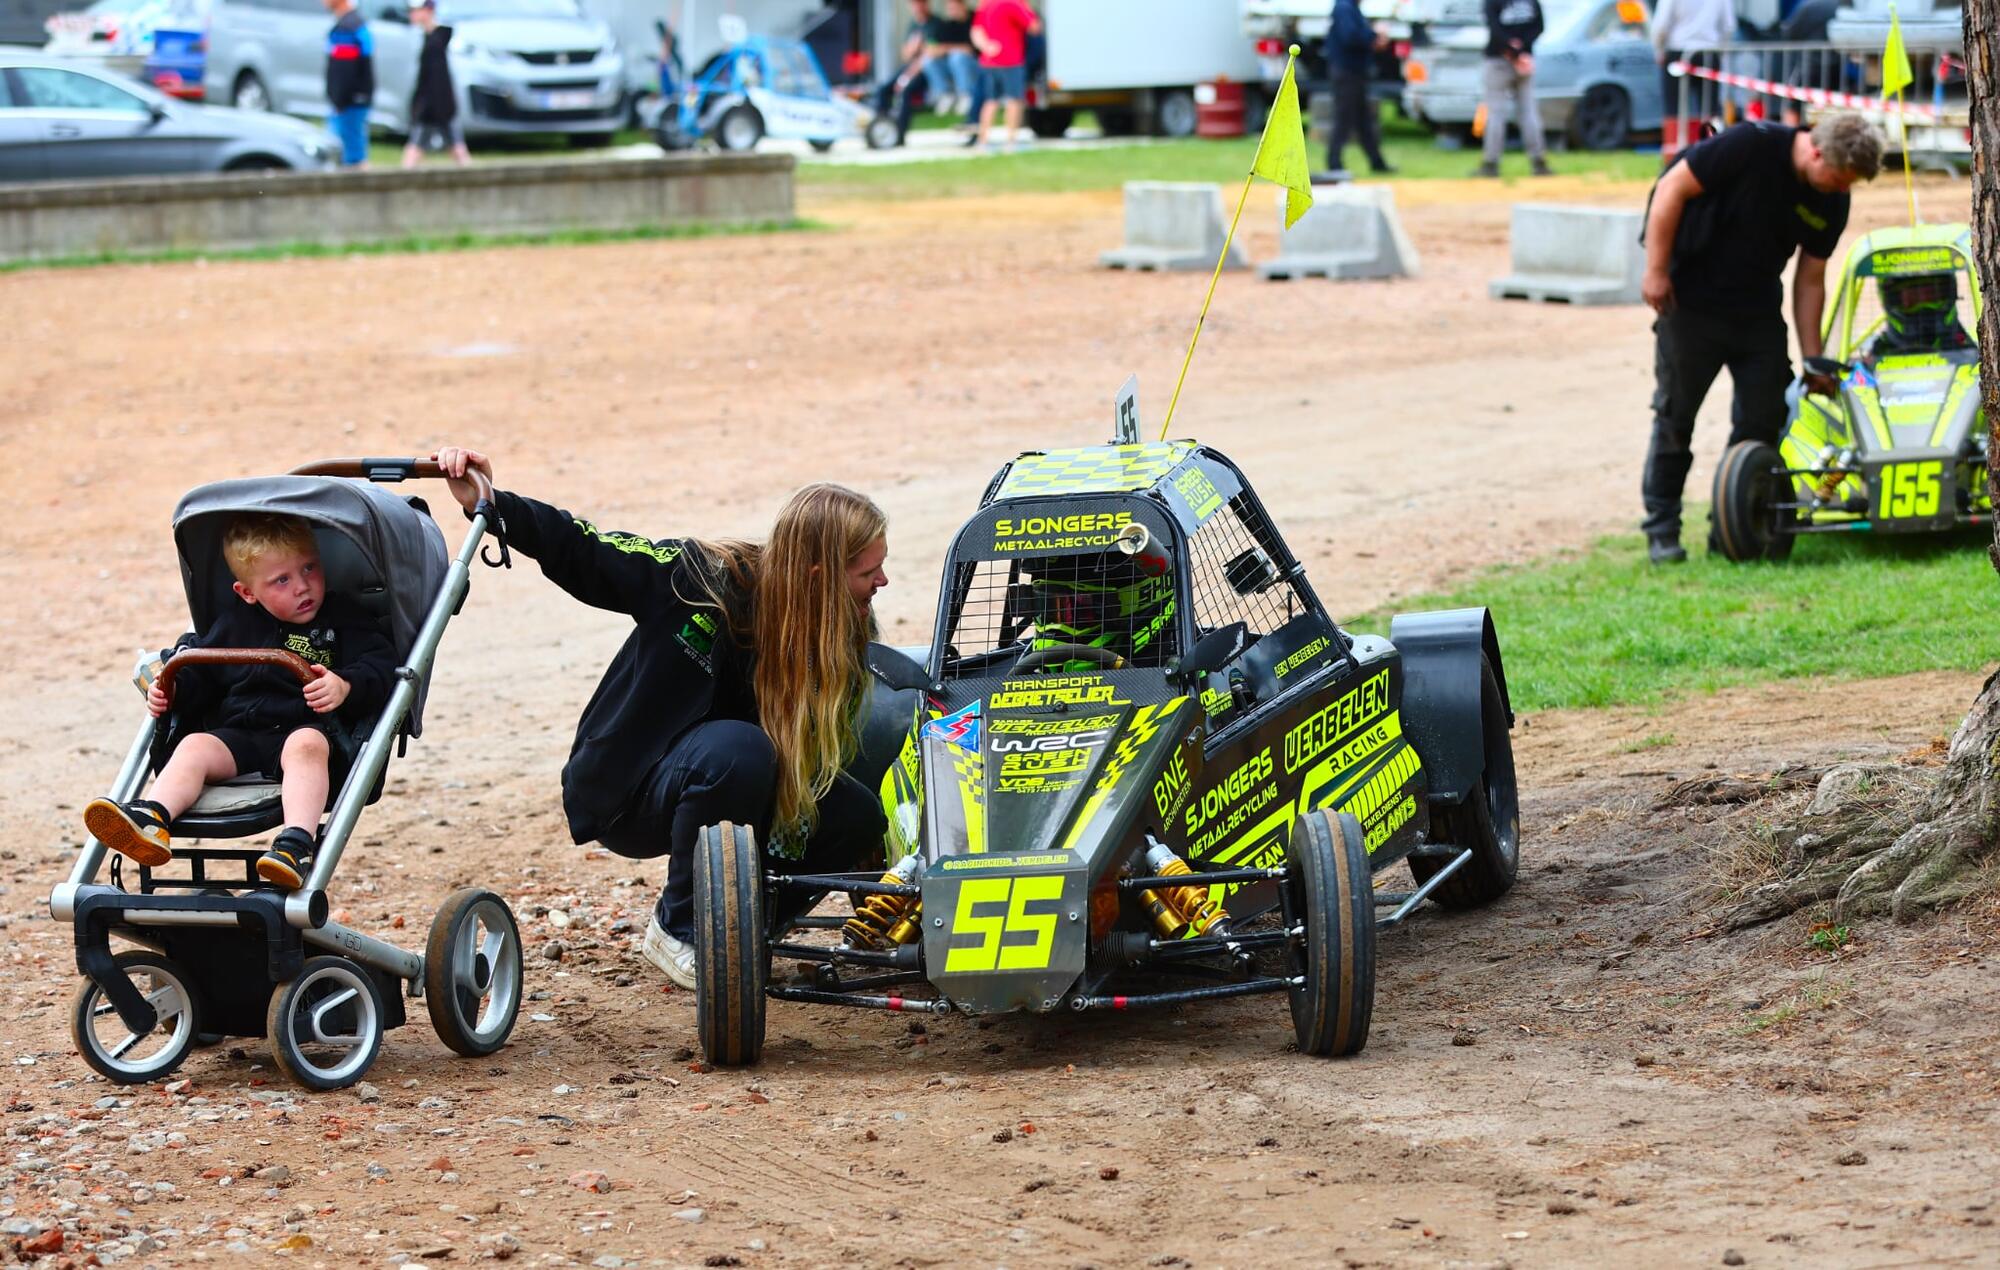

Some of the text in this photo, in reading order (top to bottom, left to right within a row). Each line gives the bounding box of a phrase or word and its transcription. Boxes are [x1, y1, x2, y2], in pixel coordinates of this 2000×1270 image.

[1184, 479, 1216, 510] RUSH
[1879, 460, 1942, 519] 155
[994, 511, 1133, 537] SJONGERS
[994, 534, 1120, 552] METAALRECYCLIN
[1002, 675, 1103, 691] TRANSPORT
[991, 729, 1109, 752] WRC
[1004, 747, 1092, 762] GREEN
[1329, 726, 1389, 774] RACING
[1001, 757, 1089, 771] RUSH
[1153, 743, 1188, 818] BNE
[1185, 745, 1274, 837] SJONGERS
[1363, 790, 1403, 831] TAKELDIENST
[1187, 780, 1278, 860] METAALRECYCLING
[1363, 793, 1417, 857] OELANTS
[944, 875, 1065, 973] 55
